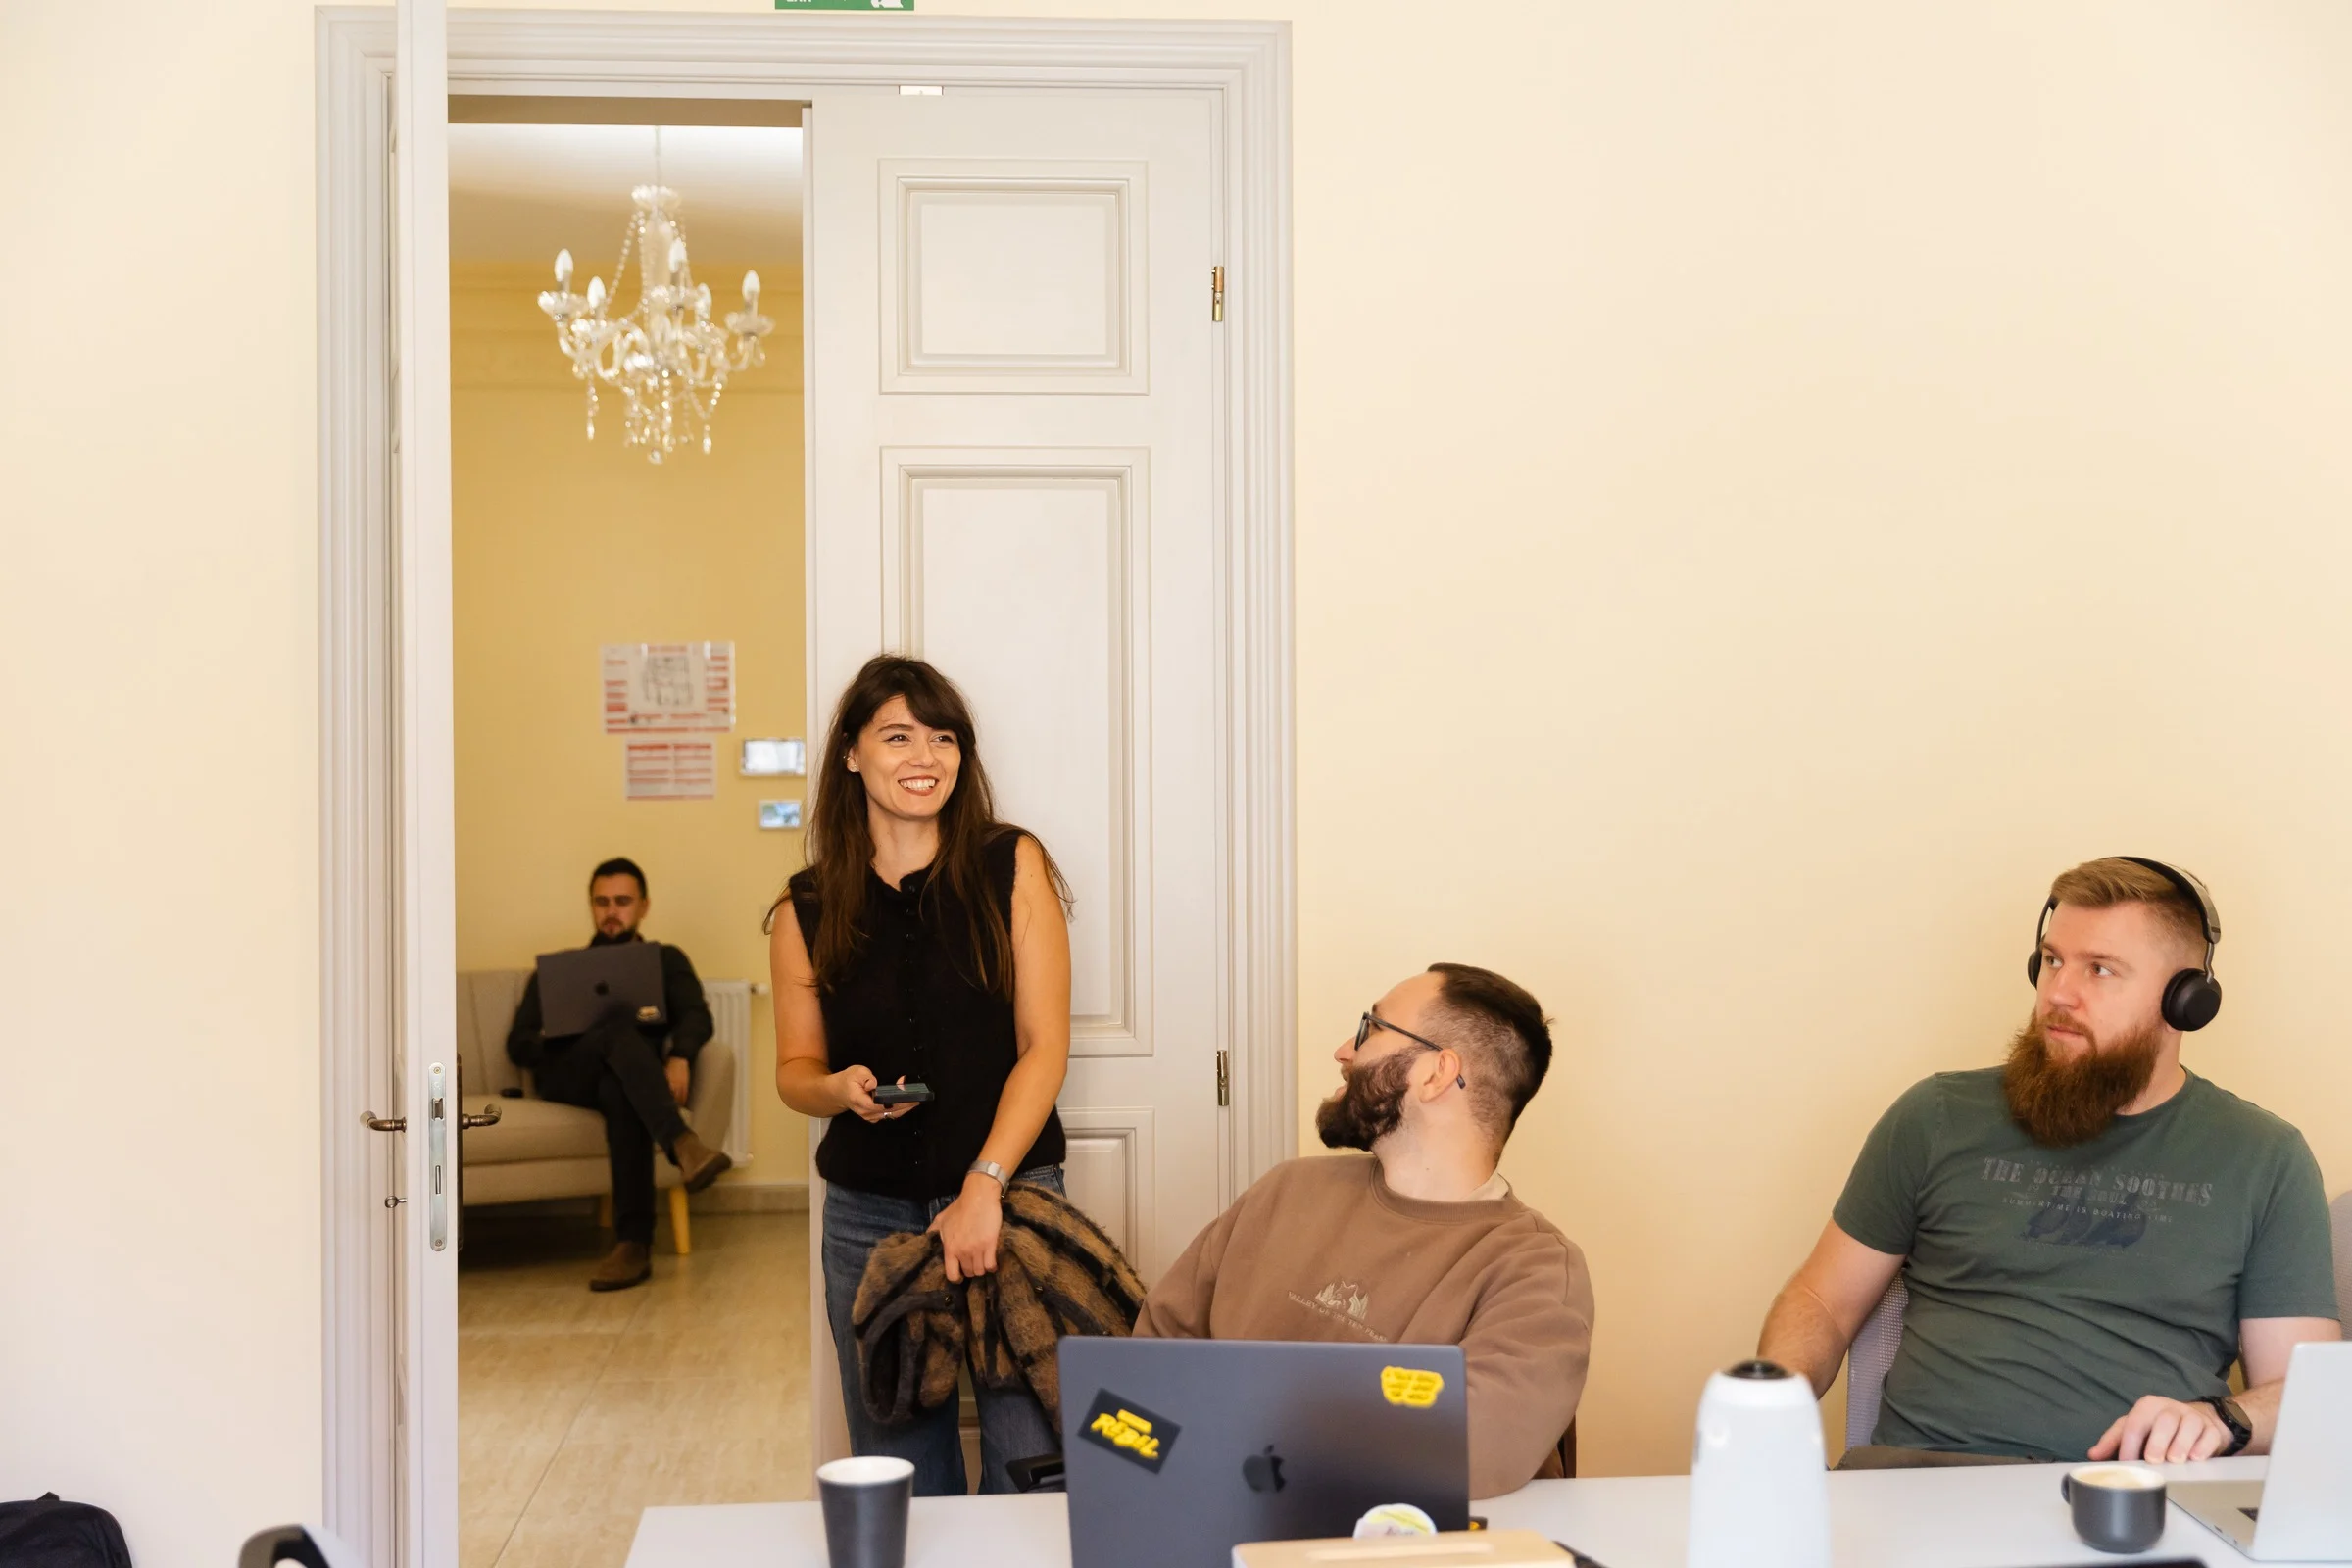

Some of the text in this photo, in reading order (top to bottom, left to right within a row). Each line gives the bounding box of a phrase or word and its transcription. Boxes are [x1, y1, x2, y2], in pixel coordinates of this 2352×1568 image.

[1980, 1156, 2025, 1183] THE
[2112, 1173, 2214, 1207] SOOTHES
[2092, 1208, 2141, 1220] BOATING
[1288, 1291, 1317, 1309] VALLEY
